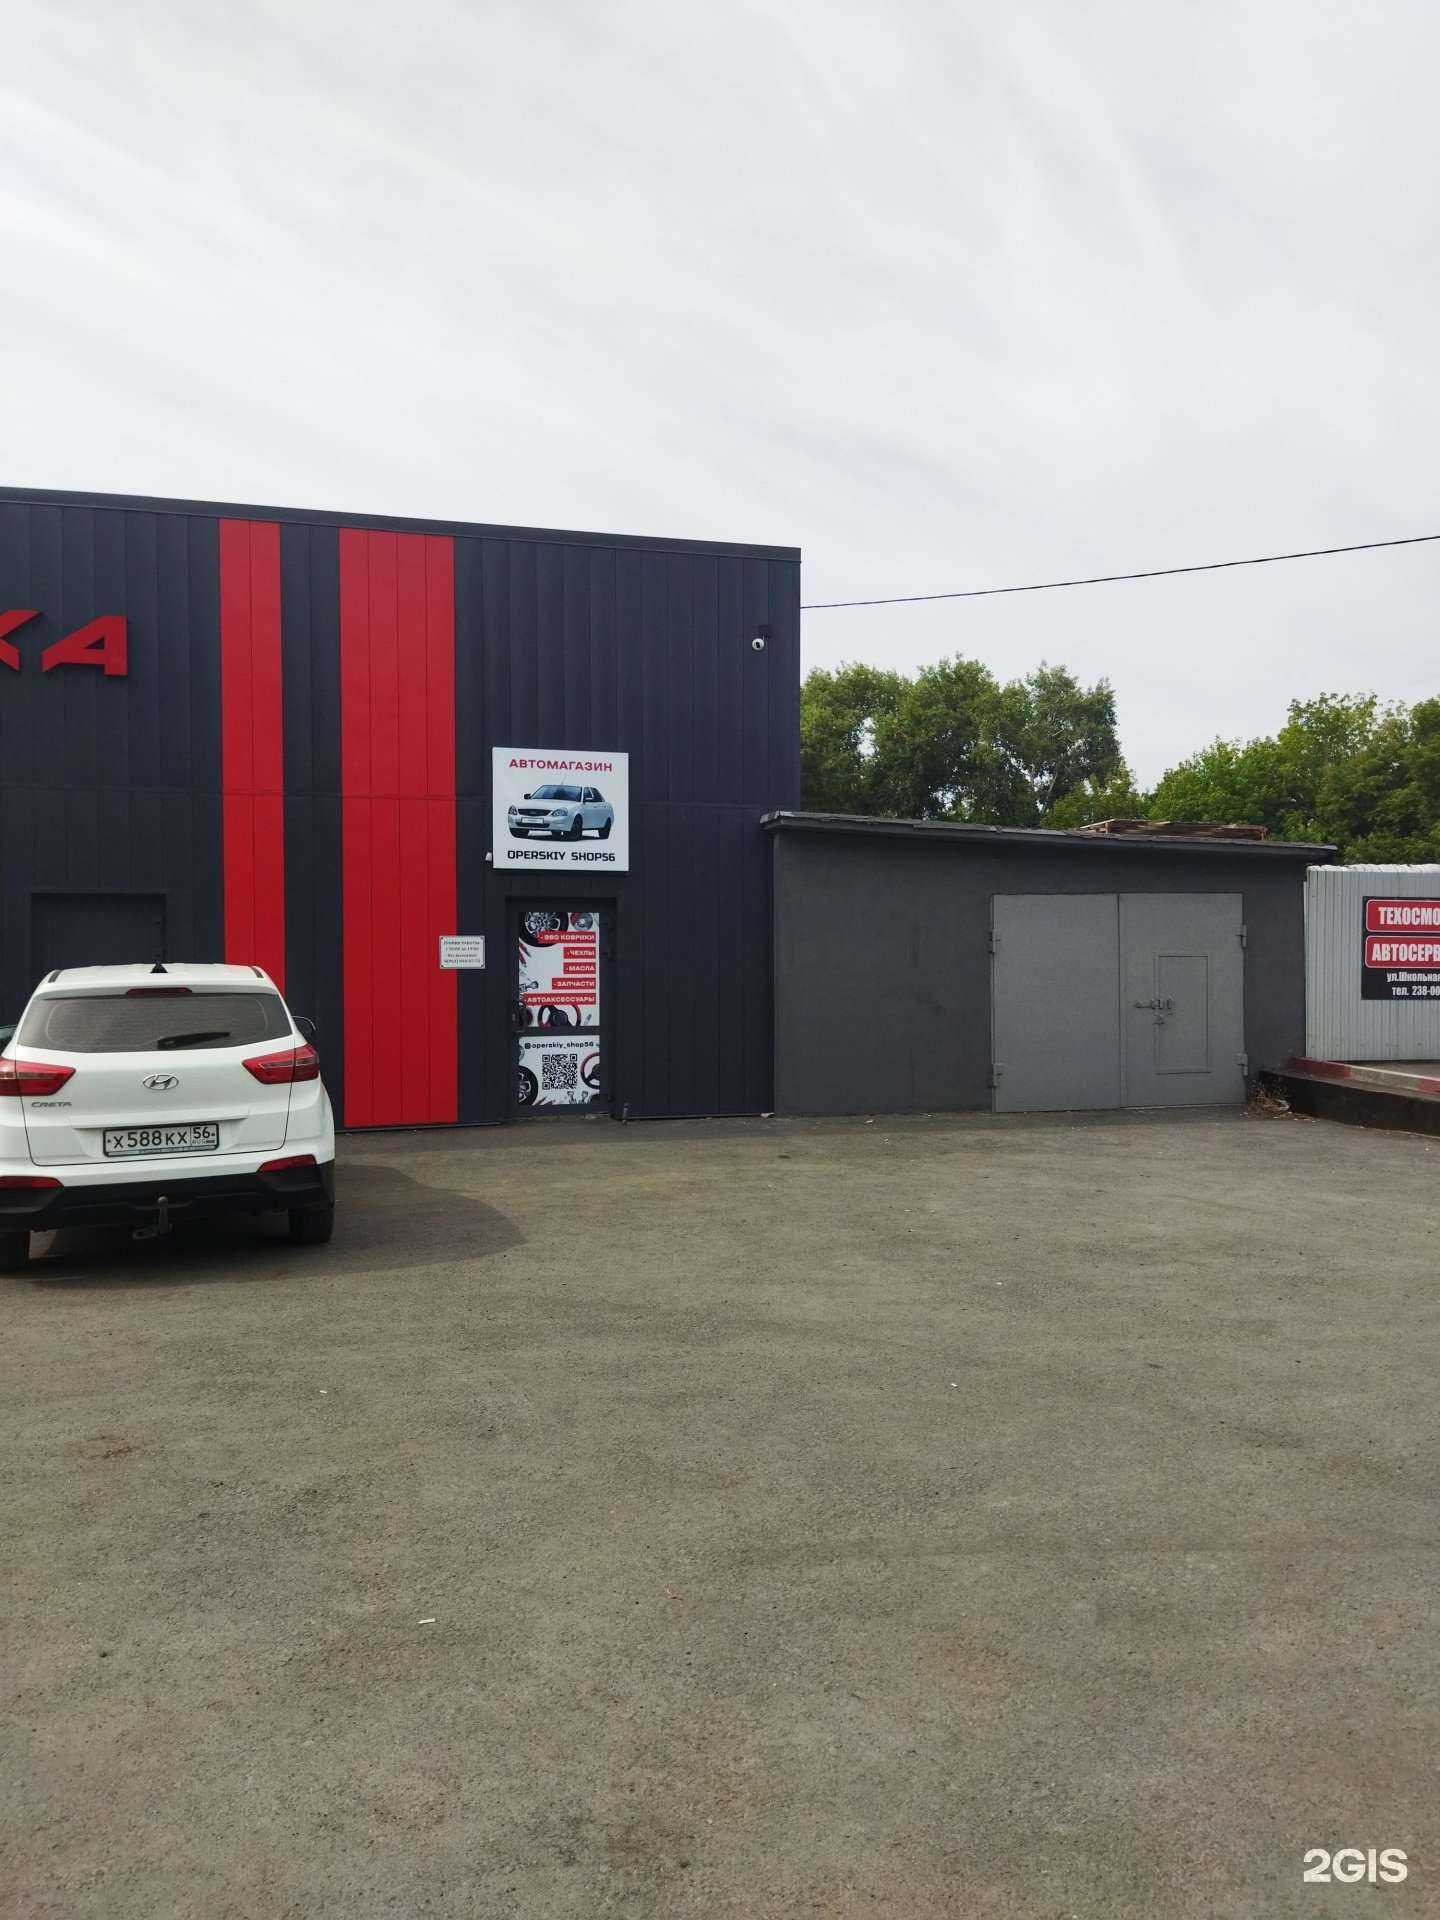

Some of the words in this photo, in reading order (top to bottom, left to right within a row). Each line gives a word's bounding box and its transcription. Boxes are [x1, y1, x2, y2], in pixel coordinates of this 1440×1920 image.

[508, 758, 613, 772] АВТОМАГАЗИН
[507, 850, 566, 861] OPERSKIY
[571, 851, 616, 862] SHOP56
[1378, 906, 1440, 926] ТЕХОСМО
[1391, 986, 1410, 996] тел.
[524, 1042, 594, 1050] @operskiy_shop56
[192, 1126, 211, 1140] 56
